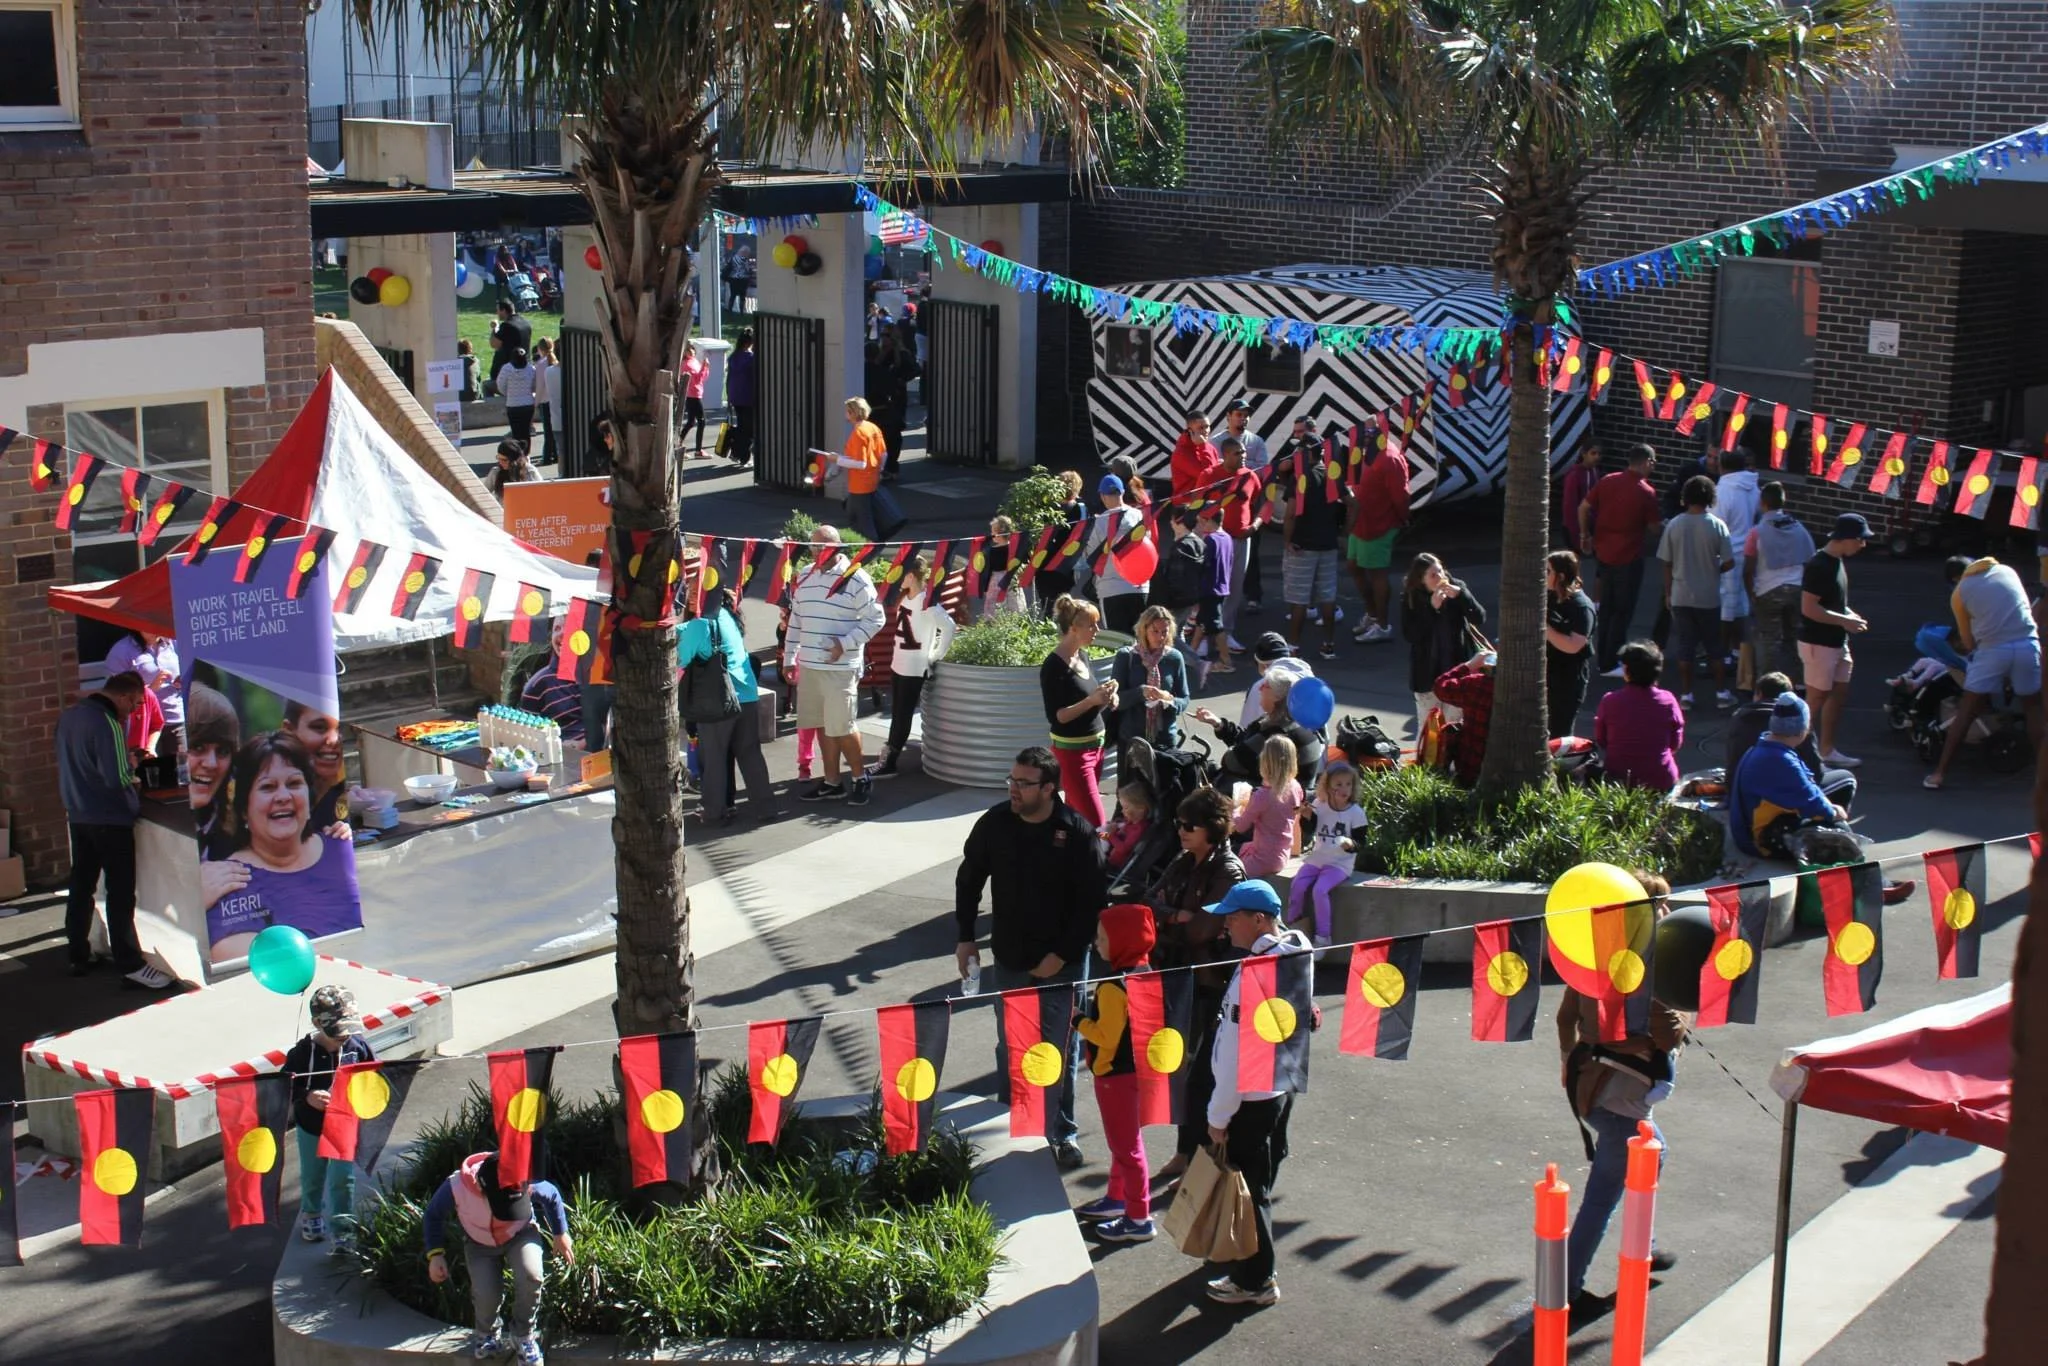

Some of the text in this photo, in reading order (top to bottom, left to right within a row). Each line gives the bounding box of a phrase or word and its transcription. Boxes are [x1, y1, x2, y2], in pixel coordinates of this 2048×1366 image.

[515, 515, 567, 529] EVEN AFTER
[528, 527, 556, 539] YEARS,
[560, 522, 587, 535] EVERY
[590, 523, 607, 534] DAY
[188, 587, 279, 614] WORK TRAVEL
[190, 600, 304, 631] GIVES ME A FEEL
[192, 619, 288, 648] FOR THE LAND.
[221, 893, 261, 917] KERRI
